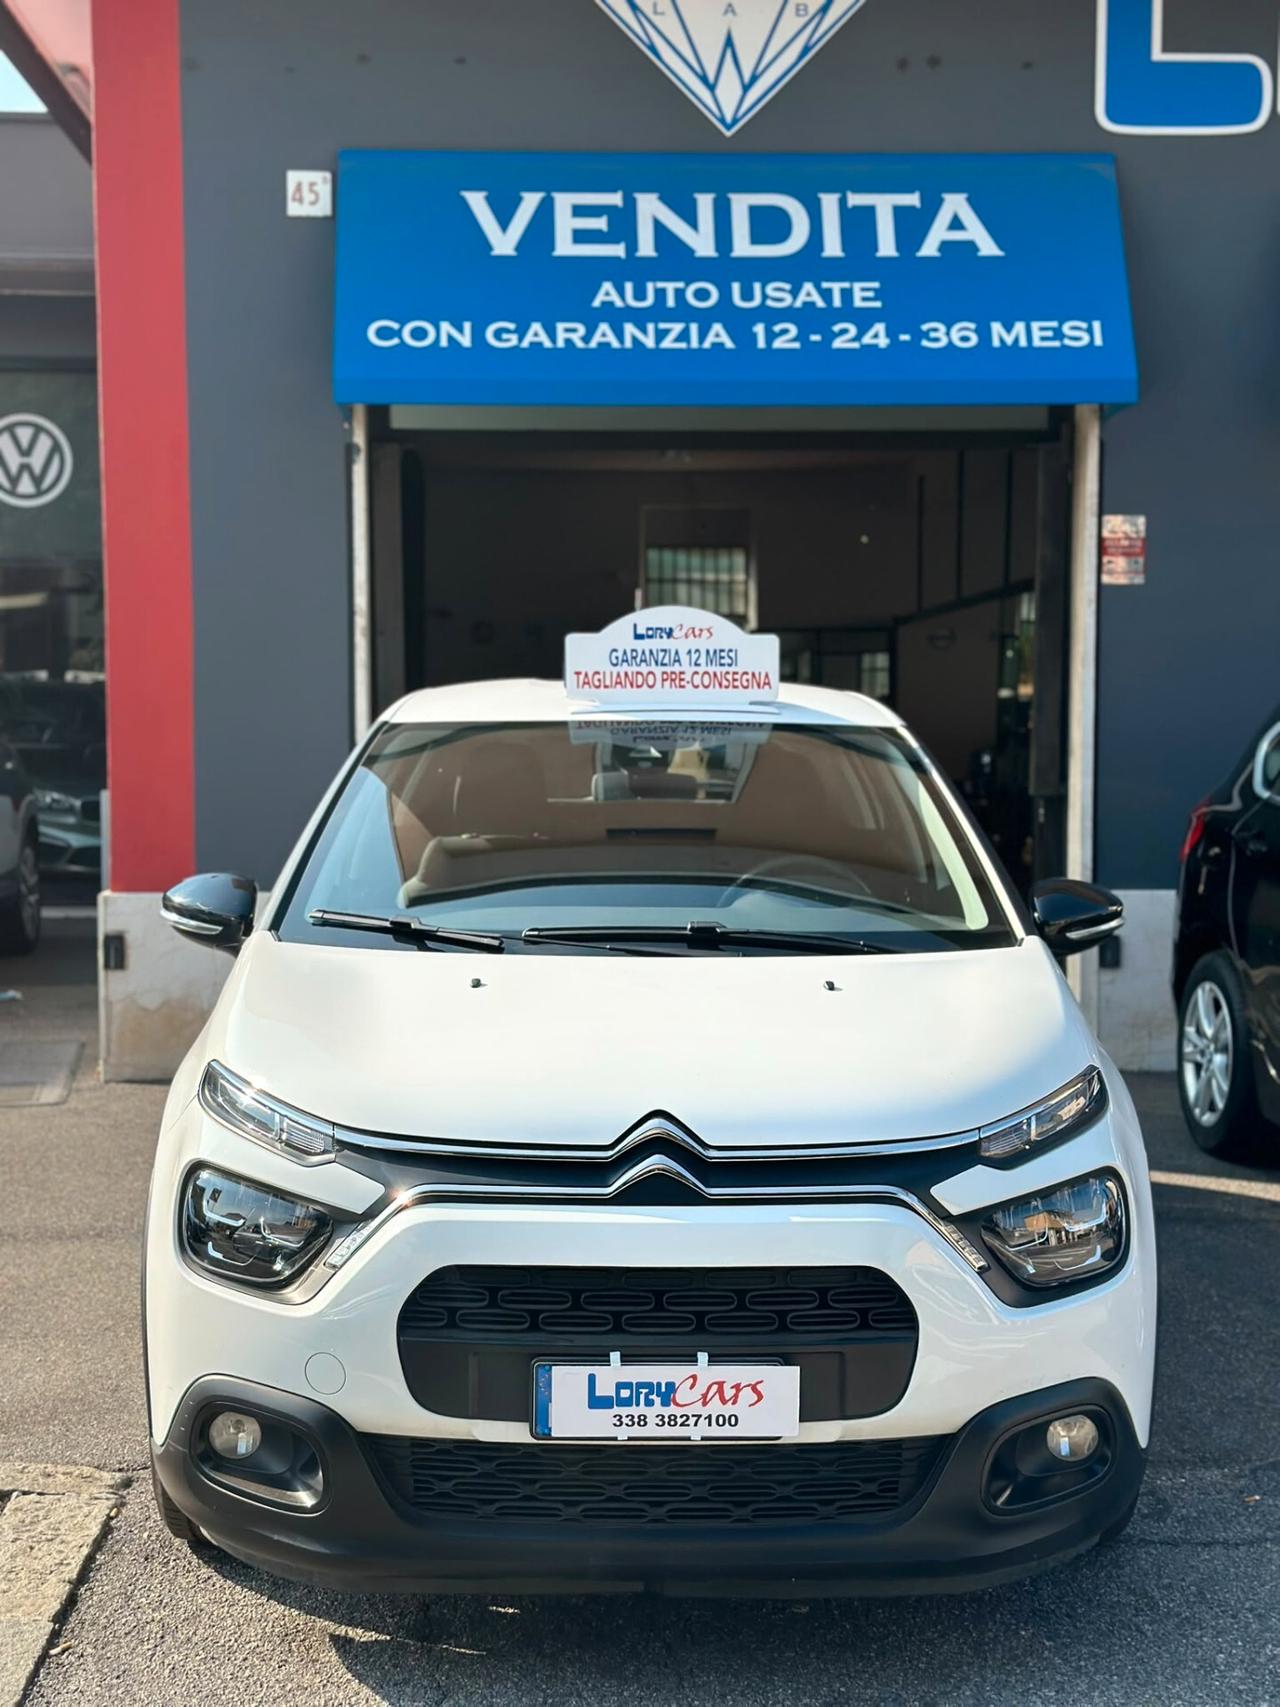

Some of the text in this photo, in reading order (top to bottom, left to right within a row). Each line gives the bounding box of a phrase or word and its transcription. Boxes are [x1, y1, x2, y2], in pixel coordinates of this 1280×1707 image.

[461, 191, 1005, 259] VENDITA
[592, 281, 882, 308] AUTO USATE
[367, 319, 472, 348] CON
[485, 321, 735, 349] GARANZIA
[753, 322, 801, 349] 12
[832, 322, 890, 349] 24
[921, 322, 978, 348] 36
[991, 320, 1104, 347] MESI
[608, 648, 738, 667] GARANZIA 12 MESI
[574, 671, 772, 690] TAGLIANDO PRE-CONSEGNA
[612, 1414, 739, 1428] 338 3827100
